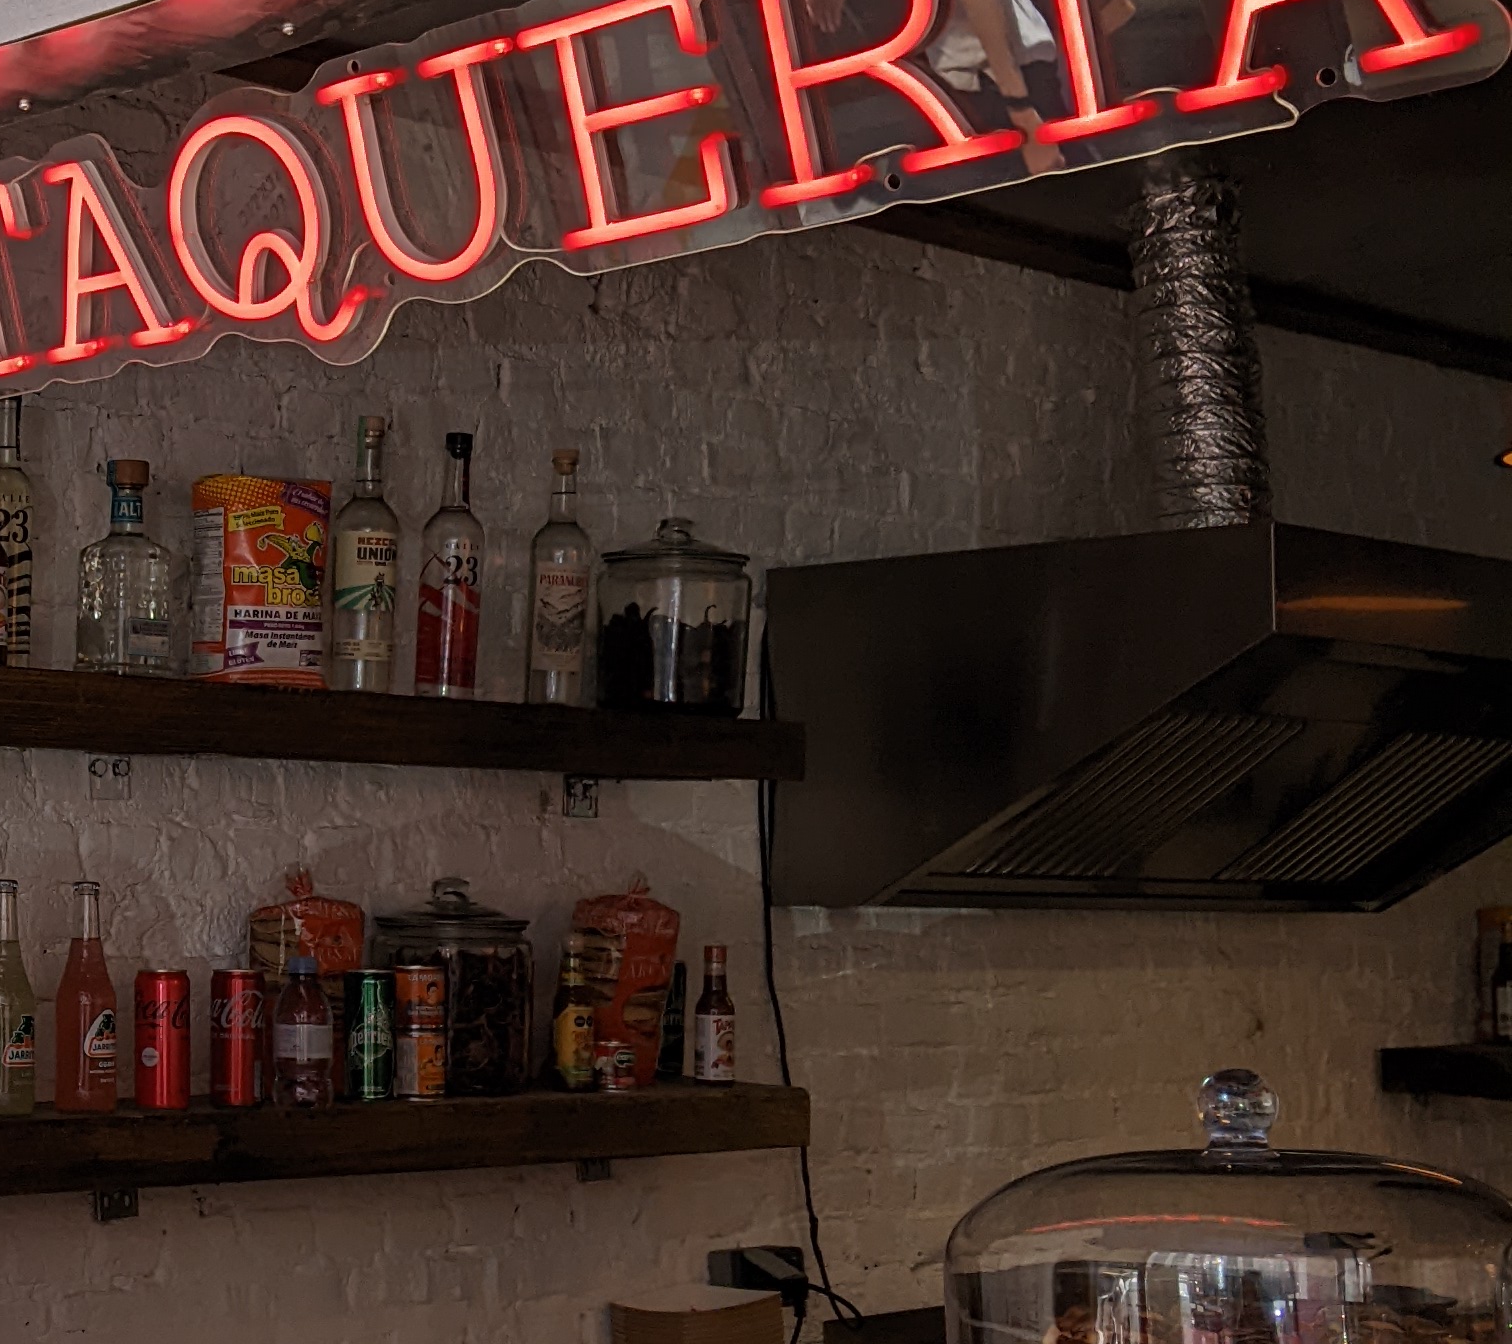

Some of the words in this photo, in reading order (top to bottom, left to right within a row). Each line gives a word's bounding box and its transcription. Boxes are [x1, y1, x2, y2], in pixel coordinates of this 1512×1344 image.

[233, 565, 301, 585] masa
[444, 555, 478, 586] 23
[234, 609, 281, 620] HARINA
[285, 611, 299, 620] DE
